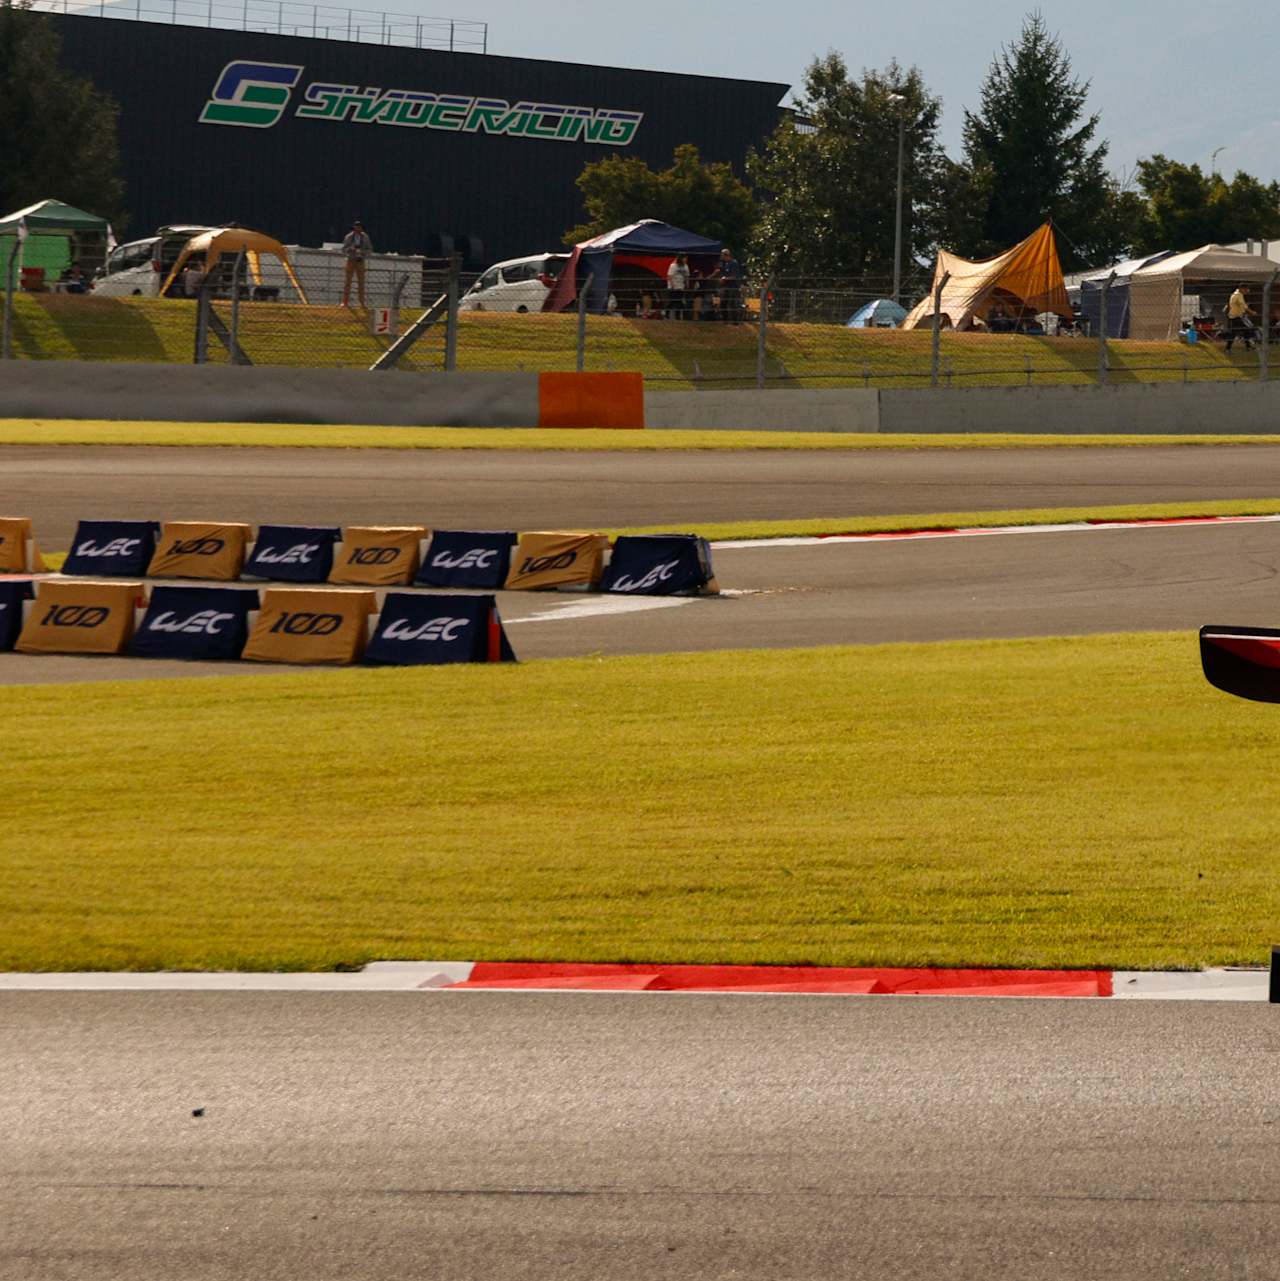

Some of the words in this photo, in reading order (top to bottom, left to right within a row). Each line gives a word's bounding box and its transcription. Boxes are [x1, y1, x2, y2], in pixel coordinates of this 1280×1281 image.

[75, 538, 141, 557] WEC
[256, 543, 319, 564] WEC
[431, 548, 498, 569] WEC
[610, 559, 680, 592] WEC
[149, 609, 235, 635] WEC
[381, 617, 470, 641] WEC
